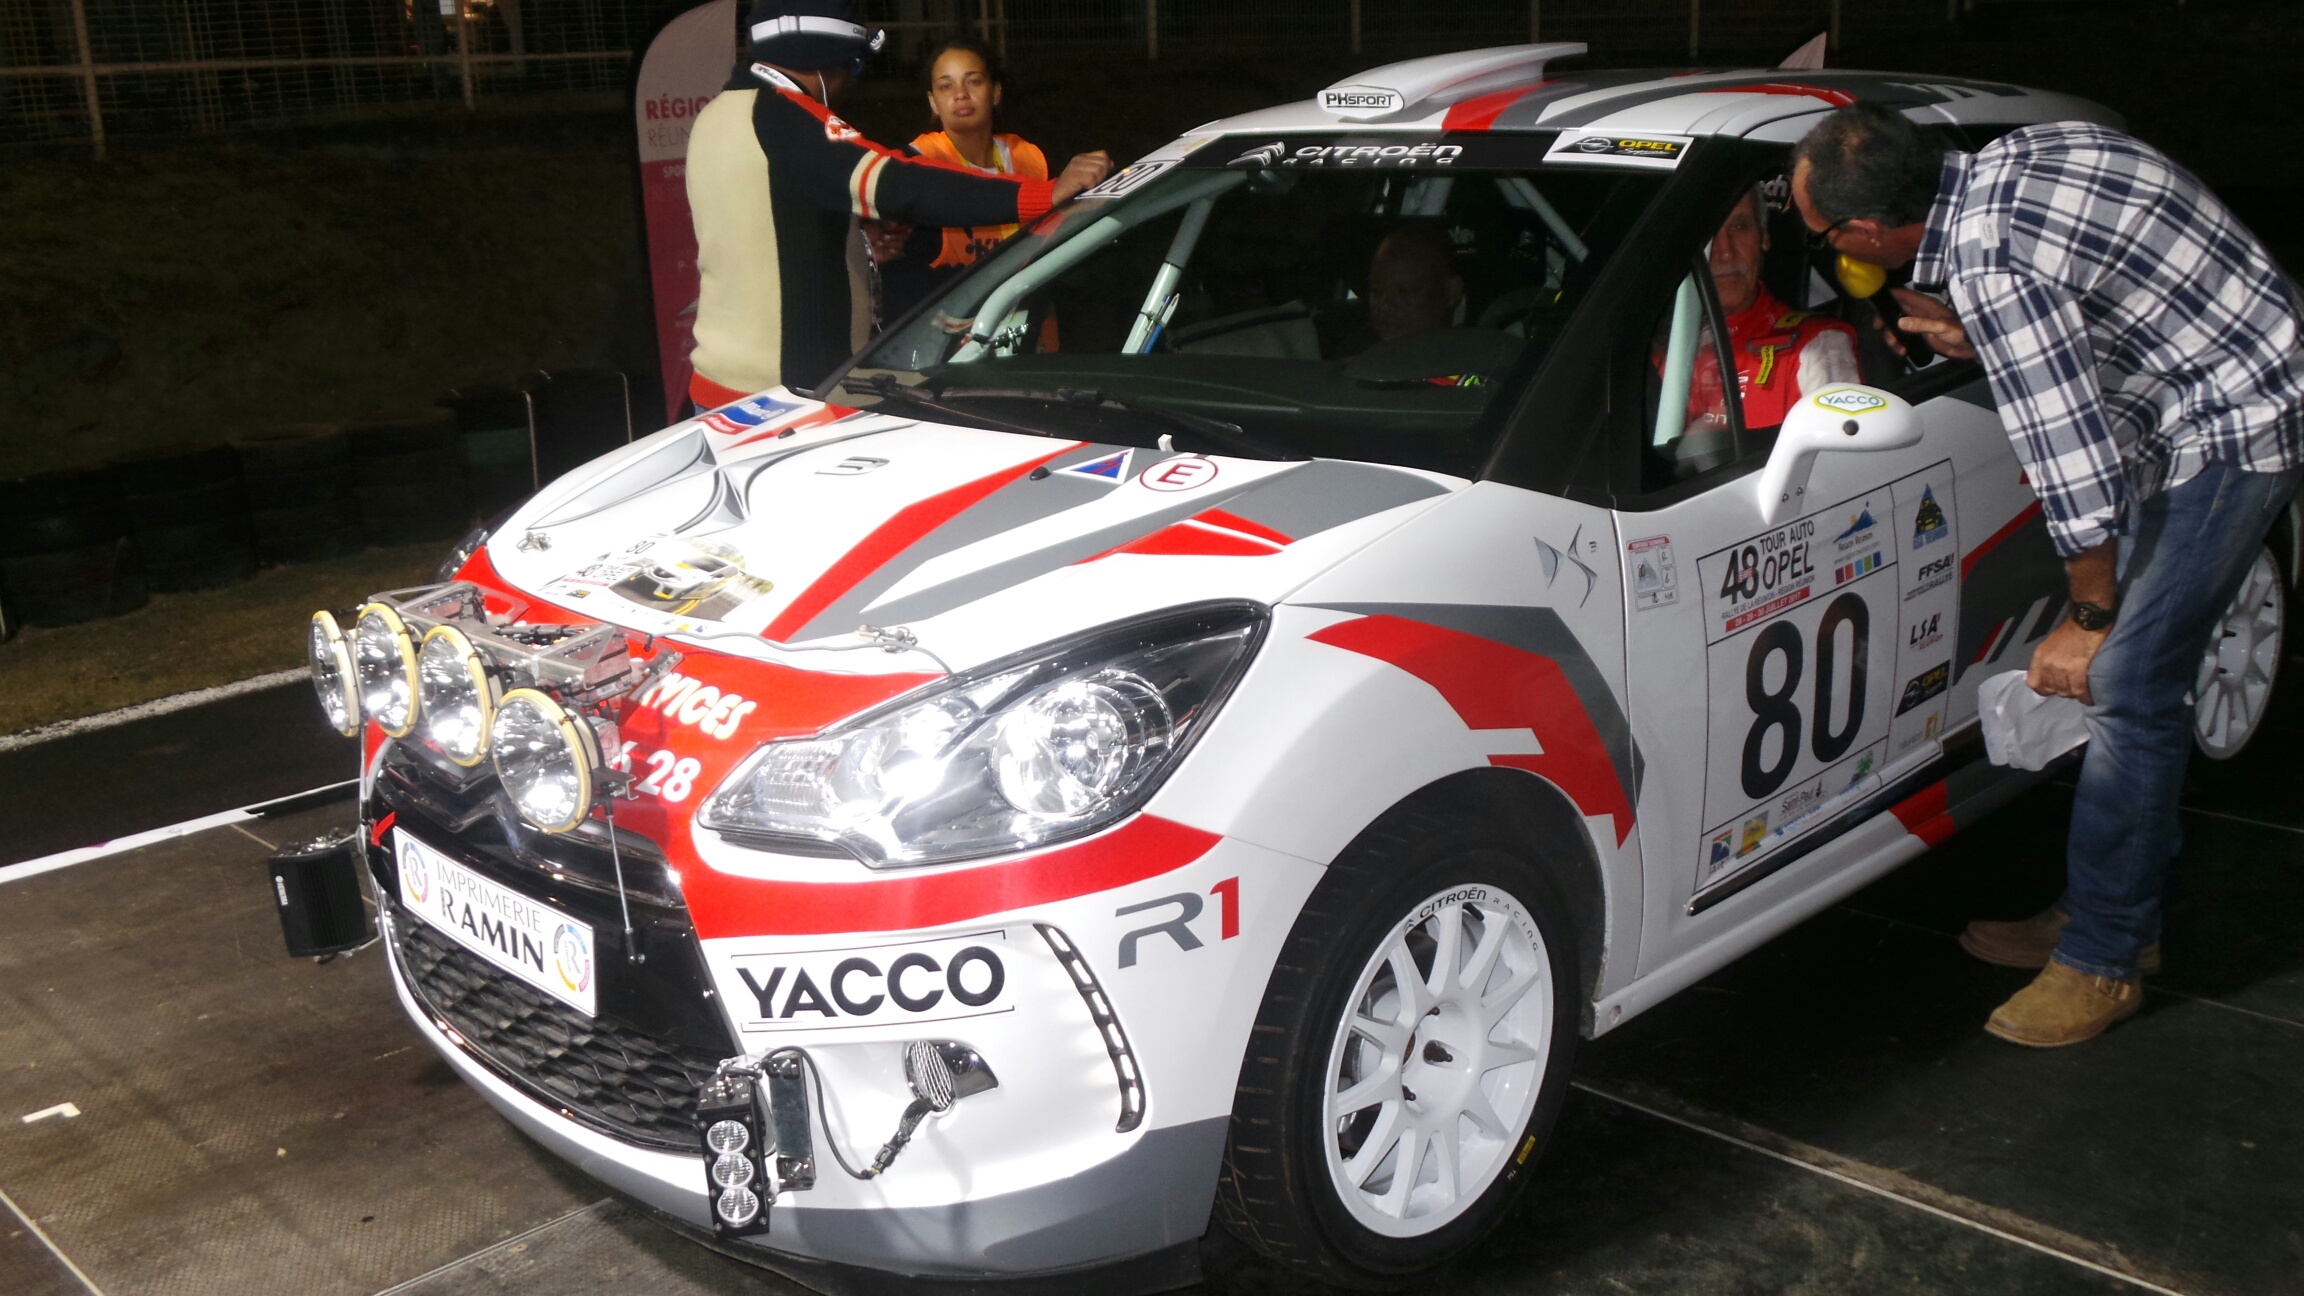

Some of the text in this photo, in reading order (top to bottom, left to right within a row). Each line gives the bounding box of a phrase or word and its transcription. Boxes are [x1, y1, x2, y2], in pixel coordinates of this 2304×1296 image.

[645, 93, 717, 121] RÉGIO
[1283, 157, 1455, 165] RACING
[1296, 143, 1463, 157] CITROËN
[1618, 139, 1677, 151] OPEL
[1824, 394, 1880, 406] YACCO
[1156, 463, 1203, 485] E
[625, 540, 656, 555] 80
[1760, 520, 1815, 555] TOUR AUTO
[1720, 545, 1759, 605] 48
[1763, 541, 1815, 590] OPEL
[1918, 554, 1952, 581] FFSA
[1765, 598, 1788, 613] JUILLET
[1788, 592, 1801, 603] 2017
[1741, 592, 1869, 799] 80
[634, 749, 701, 802] 28
[436, 860, 543, 934] IMPRIMERIE
[1419, 886, 1487, 919] CITROËN
[440, 886, 545, 974] RAMIN
[1114, 876, 1240, 970] R1
[736, 946, 1005, 1019] YACCO
